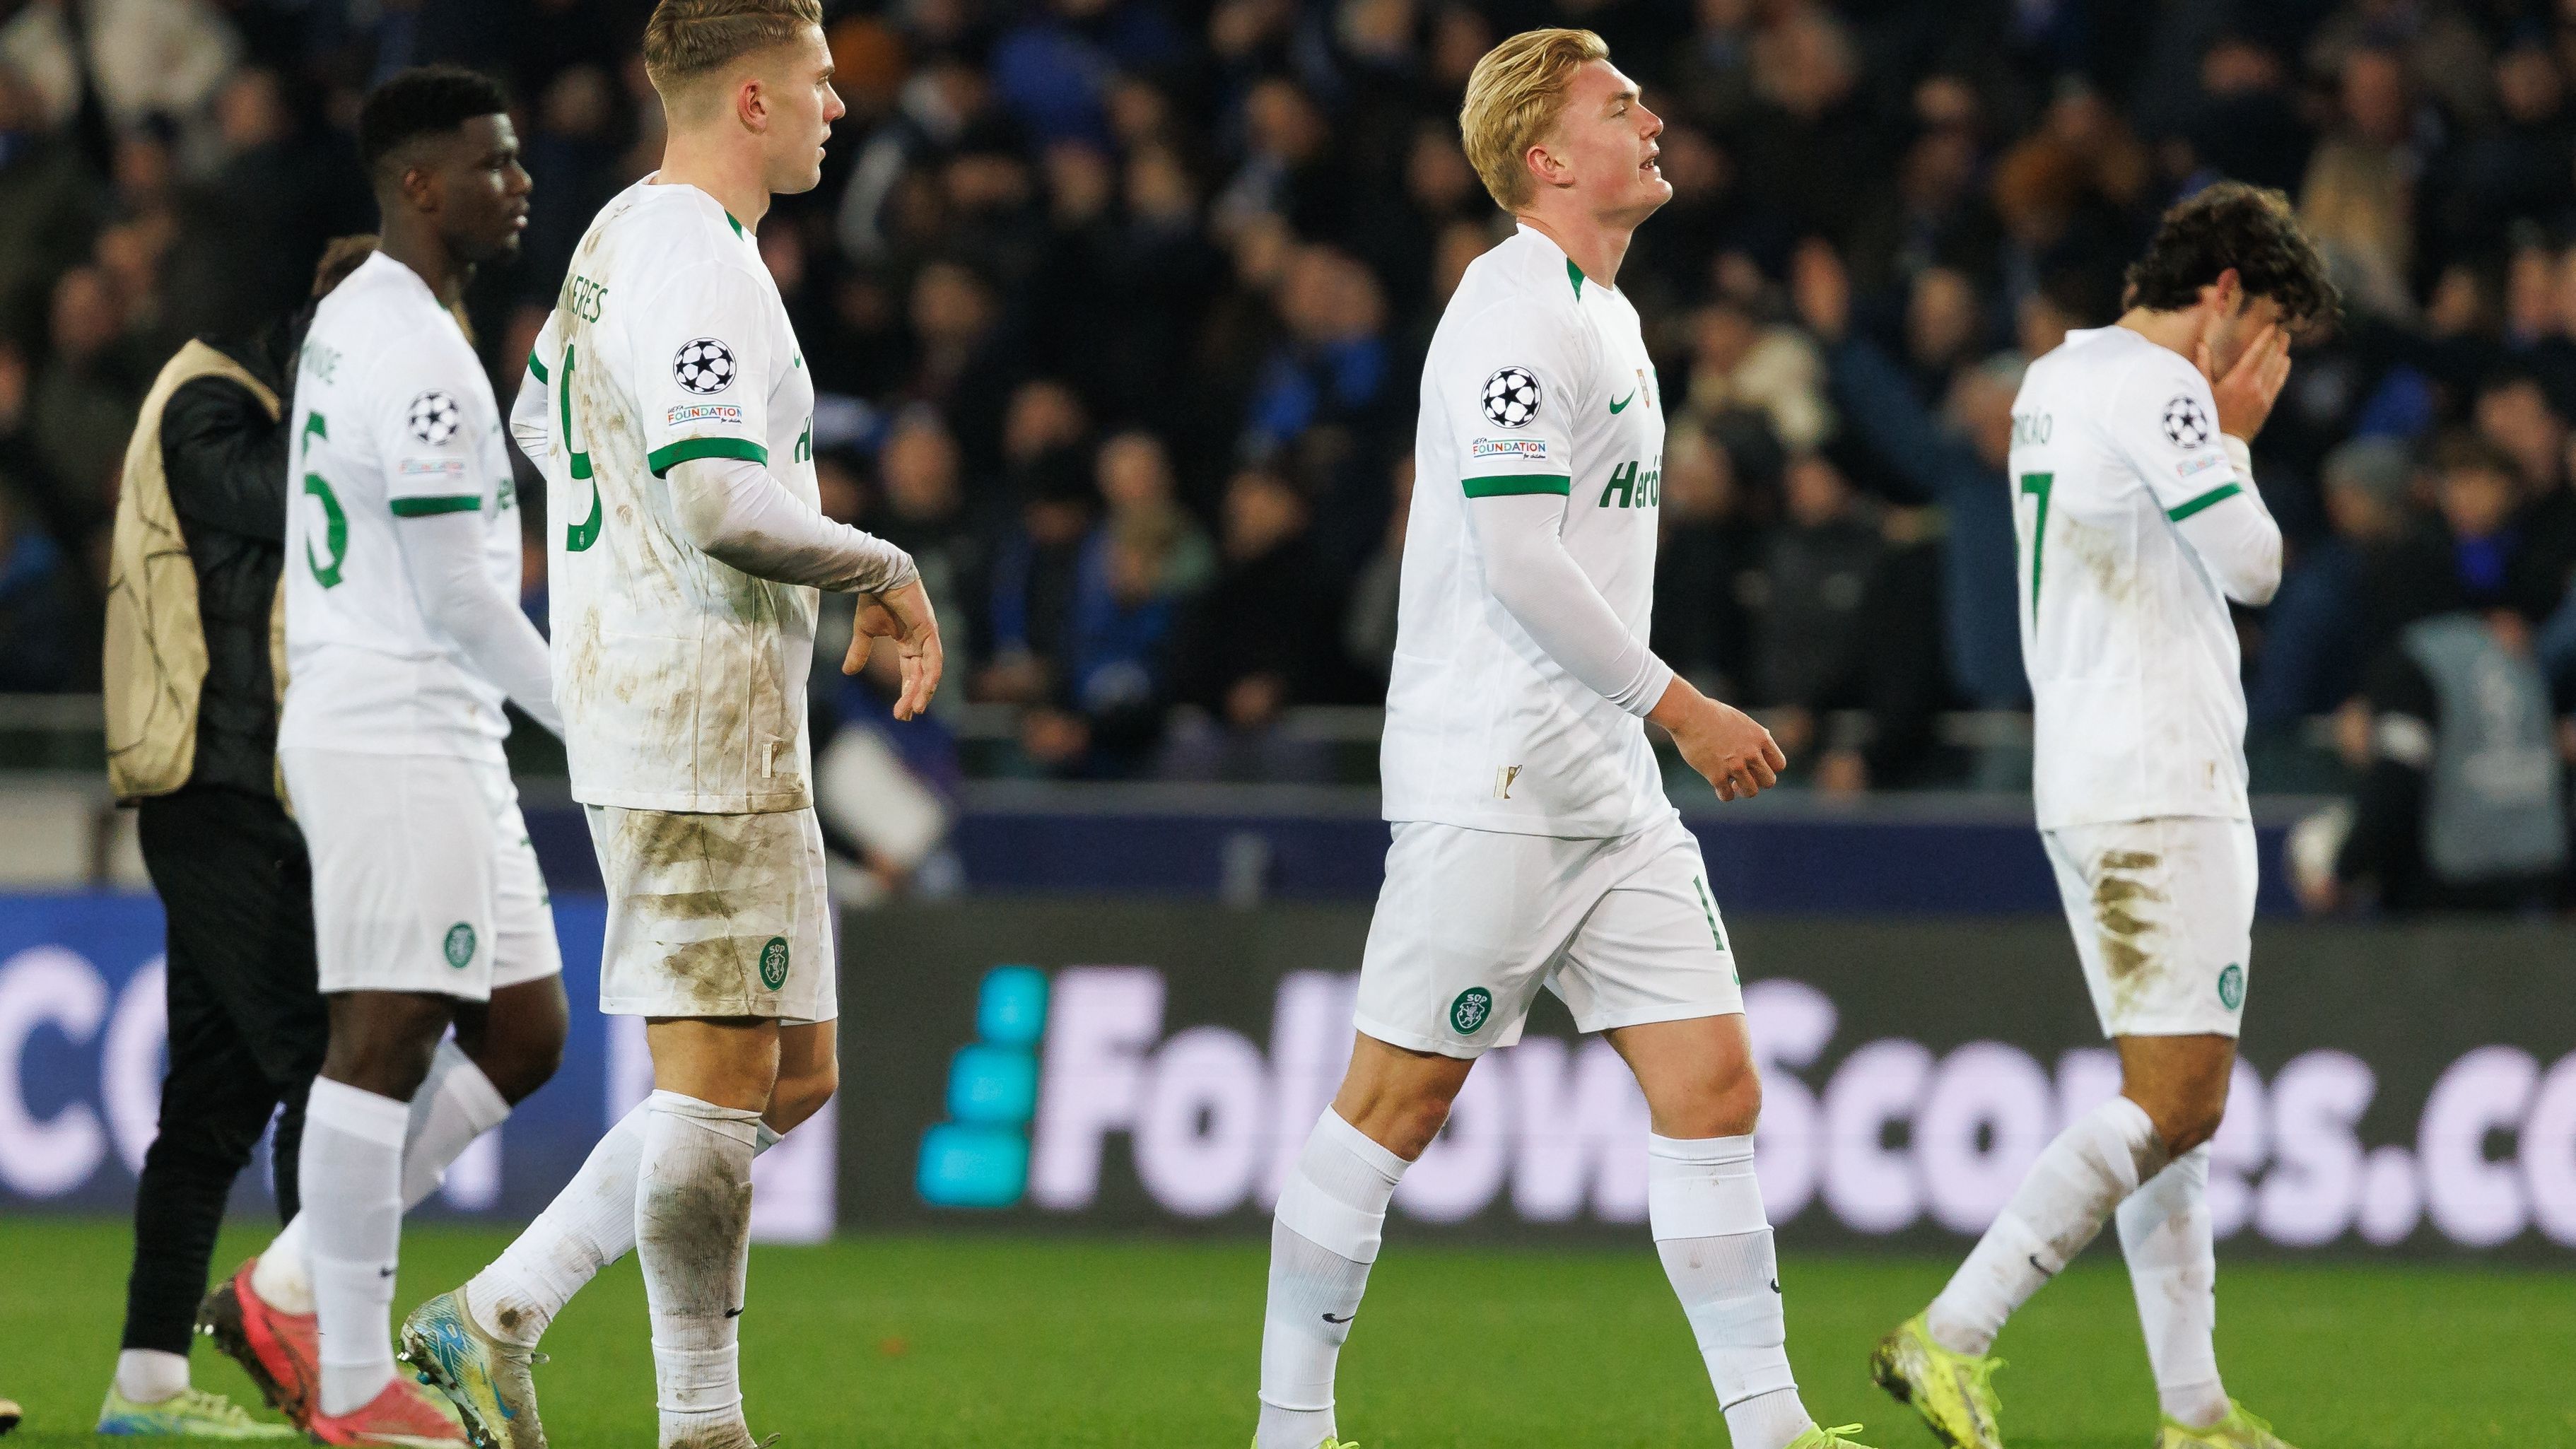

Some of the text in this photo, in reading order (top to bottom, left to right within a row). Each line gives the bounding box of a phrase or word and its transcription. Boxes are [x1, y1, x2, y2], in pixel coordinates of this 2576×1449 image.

[667, 405, 684, 414] UEFA
[667, 407, 742, 423] FOUNDATION
[1473, 442, 1546, 454] FOUNDATION
